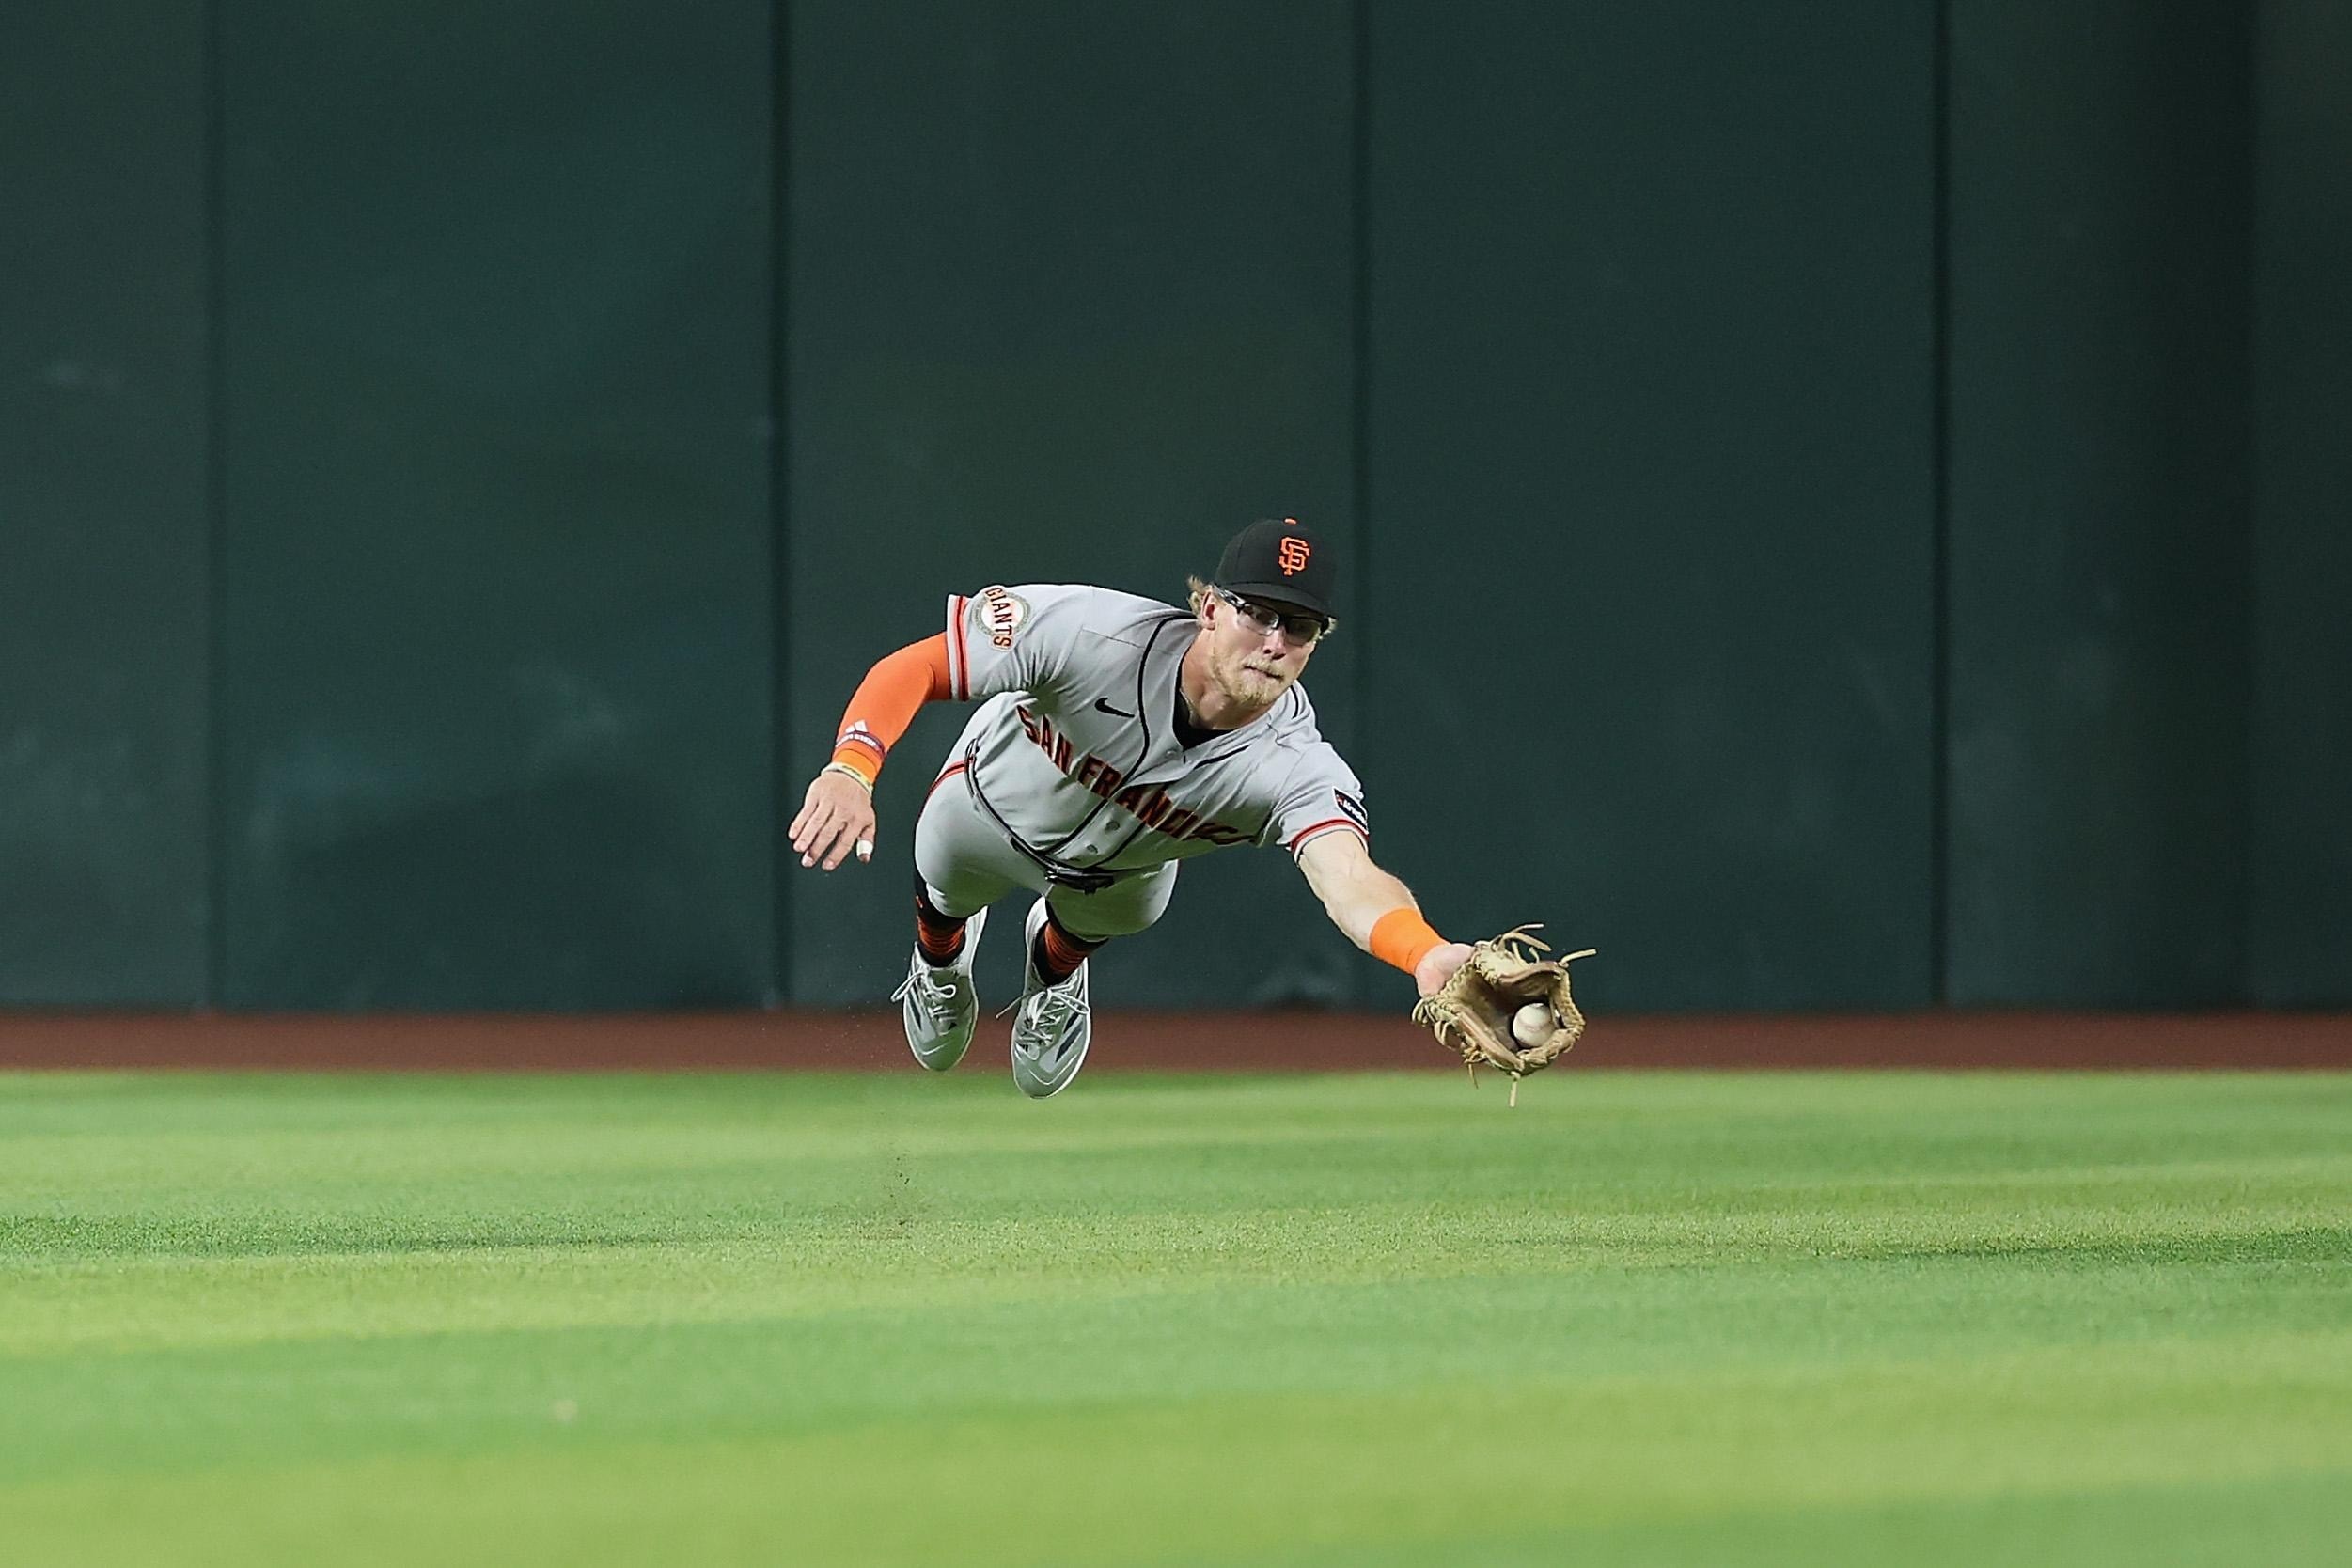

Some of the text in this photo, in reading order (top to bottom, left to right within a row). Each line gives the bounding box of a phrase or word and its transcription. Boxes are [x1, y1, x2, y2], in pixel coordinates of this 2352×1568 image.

[1278, 537, 1310, 575] SF
[985, 588, 1014, 647] GIANTS
[1015, 704, 1074, 776] SAN
